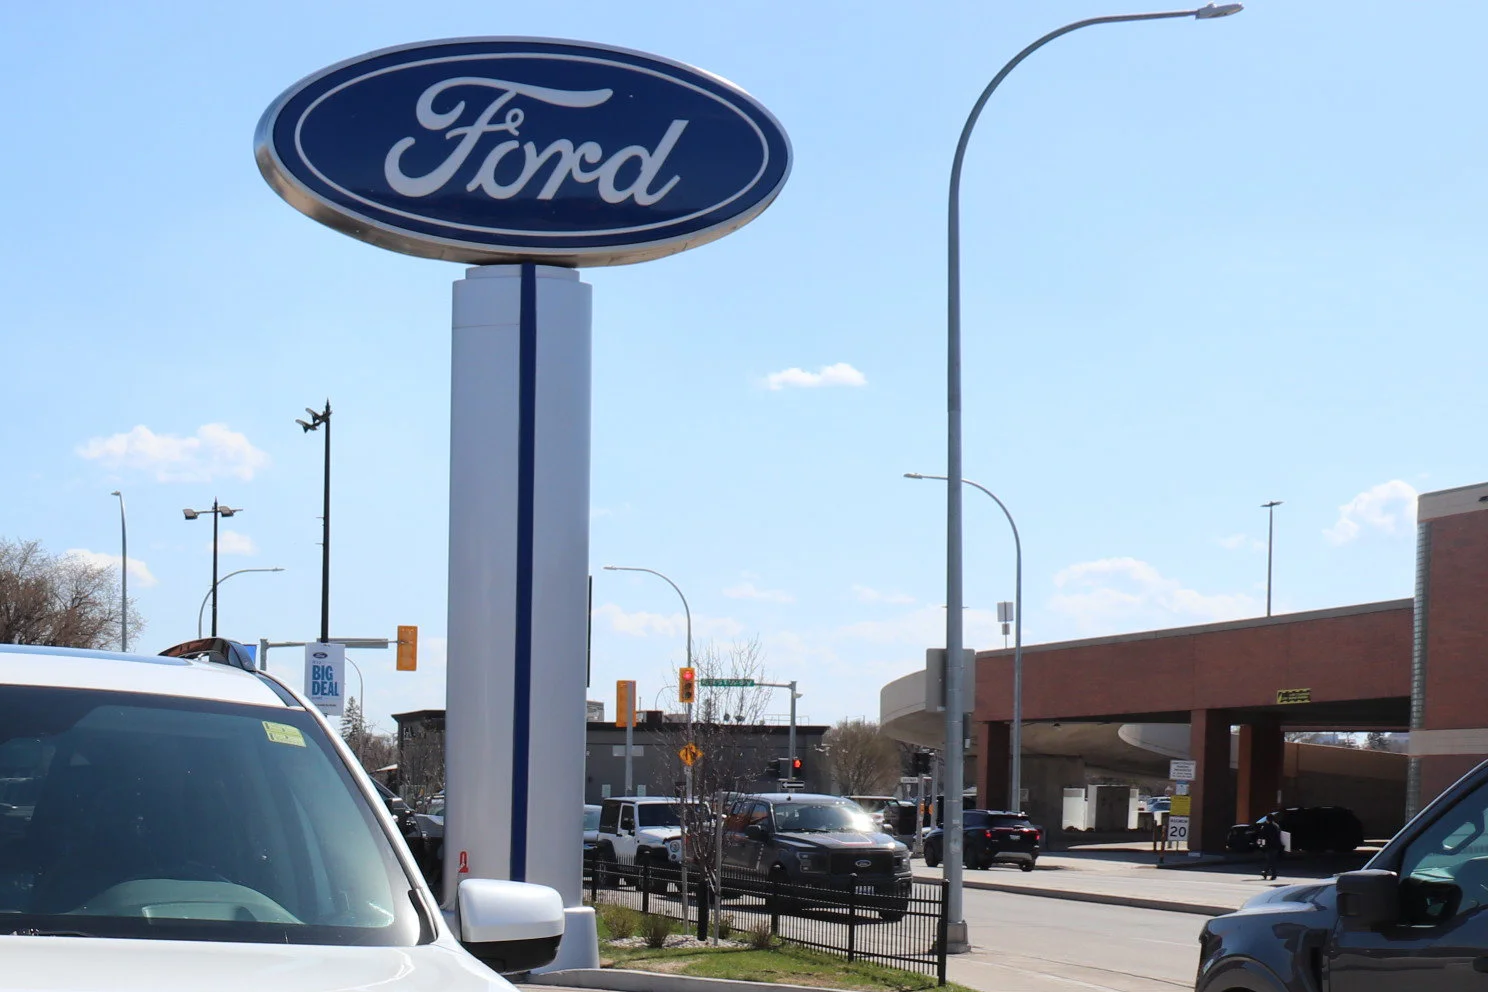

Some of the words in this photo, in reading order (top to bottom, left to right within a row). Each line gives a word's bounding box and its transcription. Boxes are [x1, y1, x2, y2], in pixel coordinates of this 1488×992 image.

[384, 76, 690, 207] Ford
[312, 665, 334, 681] BIG
[311, 680, 340, 697] DEAL
[1169, 826, 1187, 838] 20
